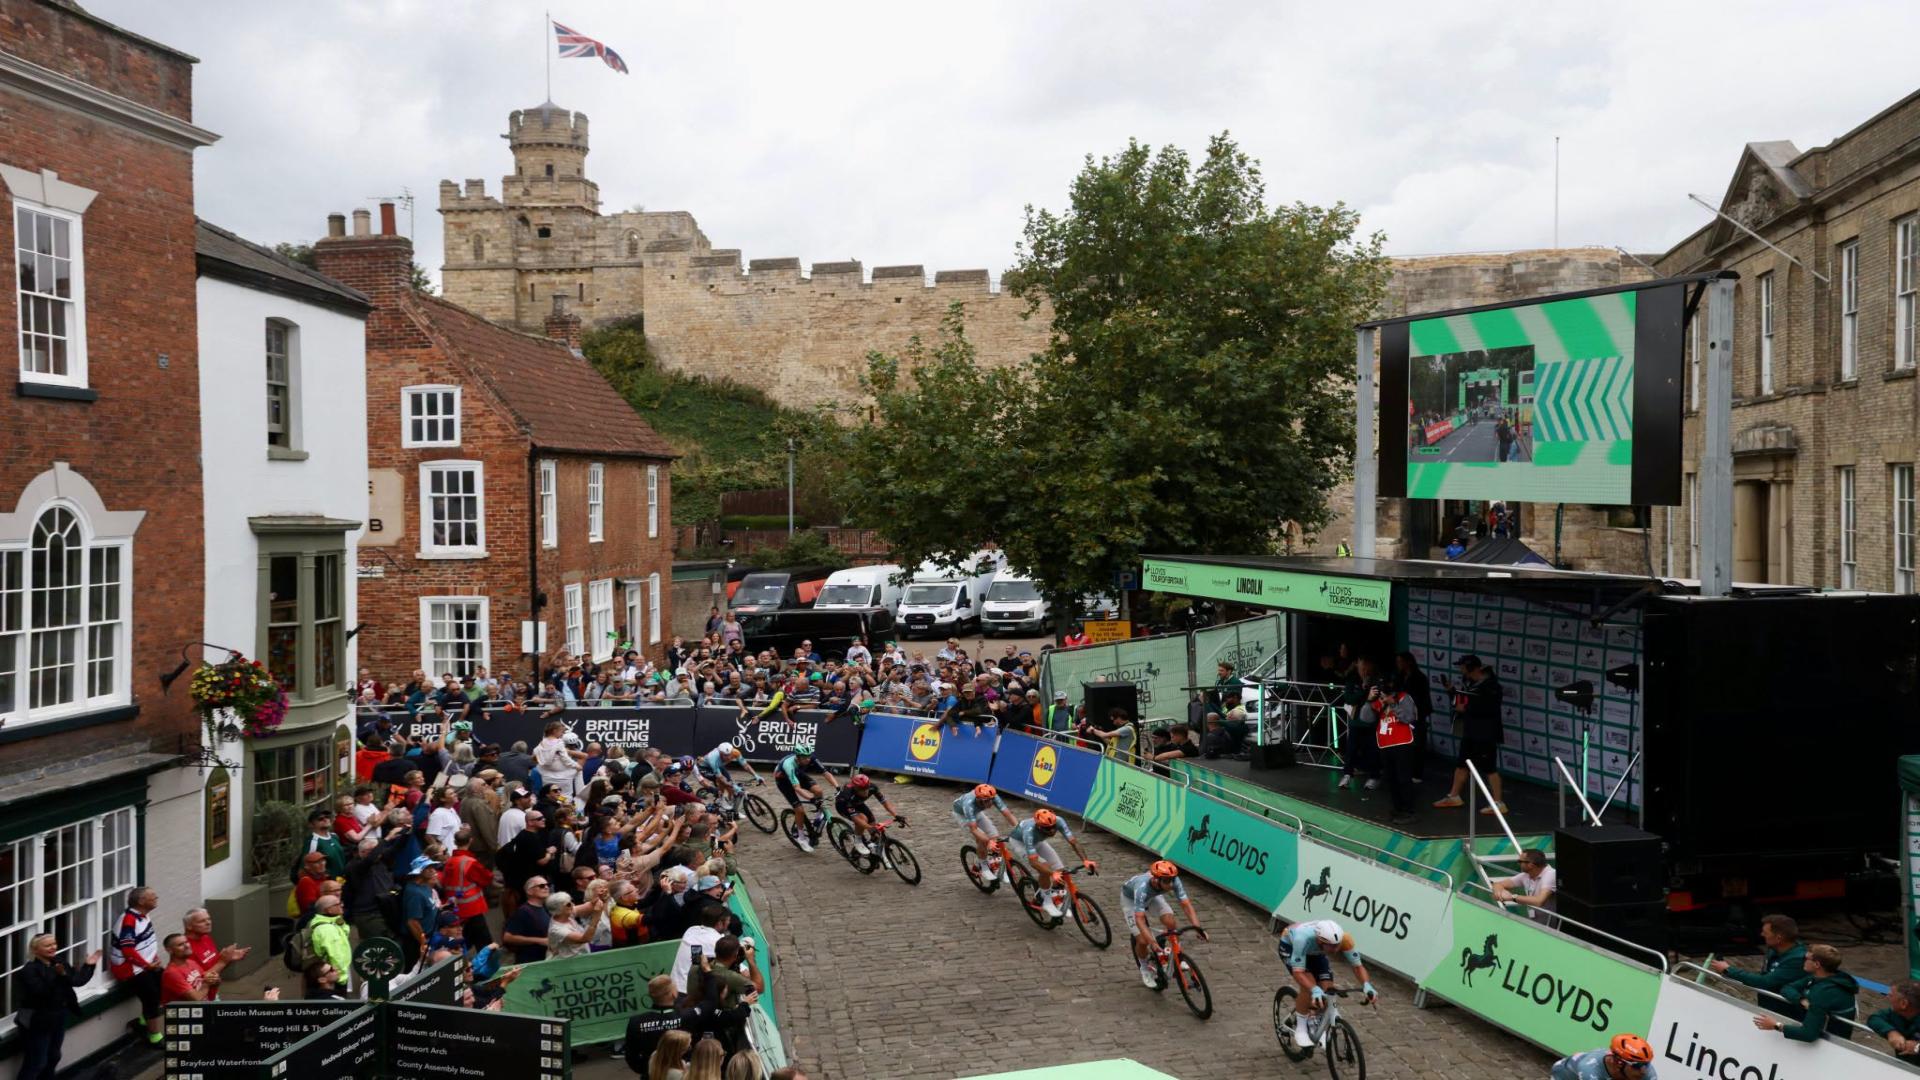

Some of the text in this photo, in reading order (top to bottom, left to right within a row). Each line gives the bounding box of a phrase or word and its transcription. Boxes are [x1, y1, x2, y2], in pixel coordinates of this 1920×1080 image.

[1236, 577, 1263, 595] LINCOLN
[1329, 585, 1351, 597] LLOYDS
[586, 719, 650, 731] BRITISH
[585, 730, 649, 742] CYCLING
[757, 732, 816, 746] CYCLING
[1124, 786, 1142, 800] LLOYDS
[1209, 831, 1269, 875] LLOYDS
[1332, 886, 1411, 940] LLOYDS
[563, 970, 634, 993] LLOYDS
[552, 984, 635, 1009] TOUR OF
[1502, 959, 1613, 1032] LLOYDS
[217, 1009, 246, 1017] Lincoln
[321, 1008, 352, 1017] Gallery
[397, 1010, 427, 1020] Bailgate
[554, 997, 638, 1020] BRITAIN
[259, 1025, 284, 1034] Steep
[397, 1027, 495, 1044] Museum of Lincolnshire Life
[260, 1042, 280, 1051] High
[397, 1043, 447, 1055] Newport Arch
[1665, 1022, 1784, 1080] Lincol
[180, 1059, 261, 1068] Brayford Waterfront
[397, 1059, 484, 1076] County Assembly Rooms
